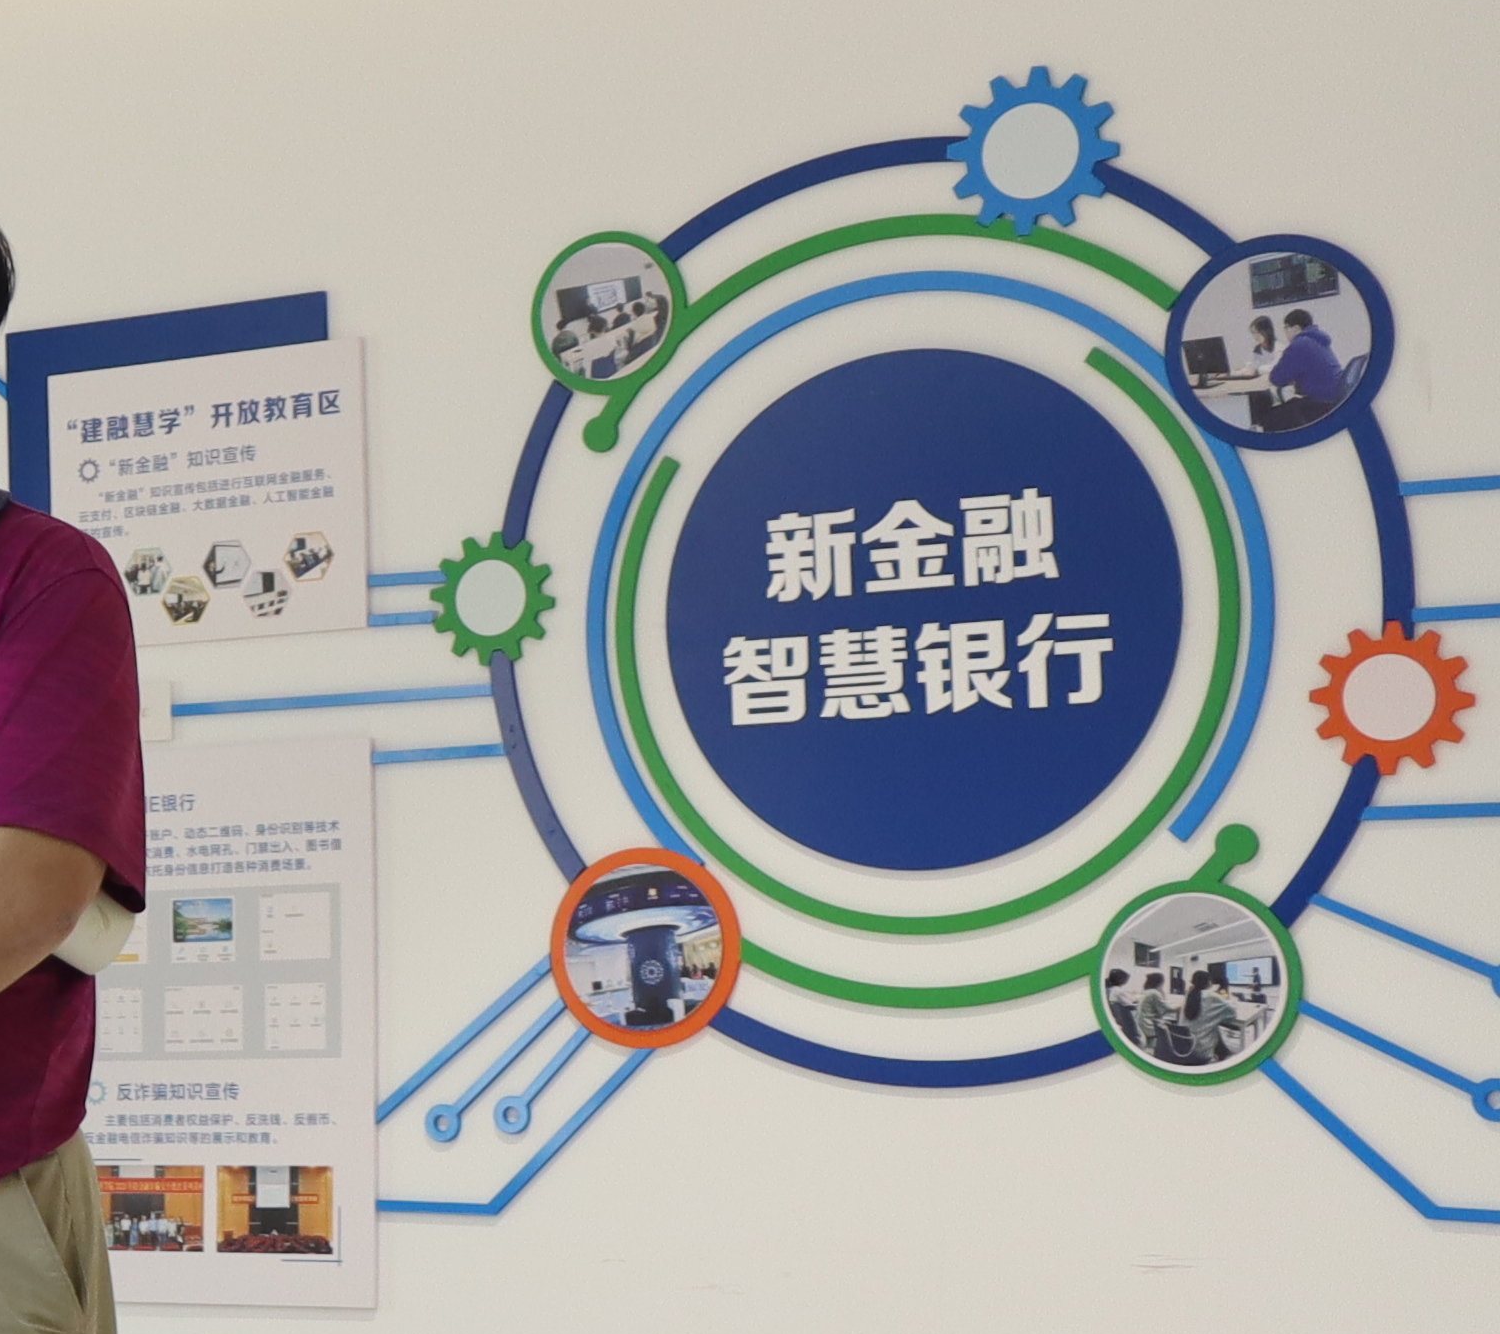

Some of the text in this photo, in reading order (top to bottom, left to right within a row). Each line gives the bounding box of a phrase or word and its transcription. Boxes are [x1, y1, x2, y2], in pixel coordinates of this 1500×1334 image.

[764, 487, 1060, 604] 新金融
[722, 612, 1114, 727] 智慧银行
[144, 793, 196, 814] E银行
[116, 1082, 240, 1101] 反诈骗知识宣传
